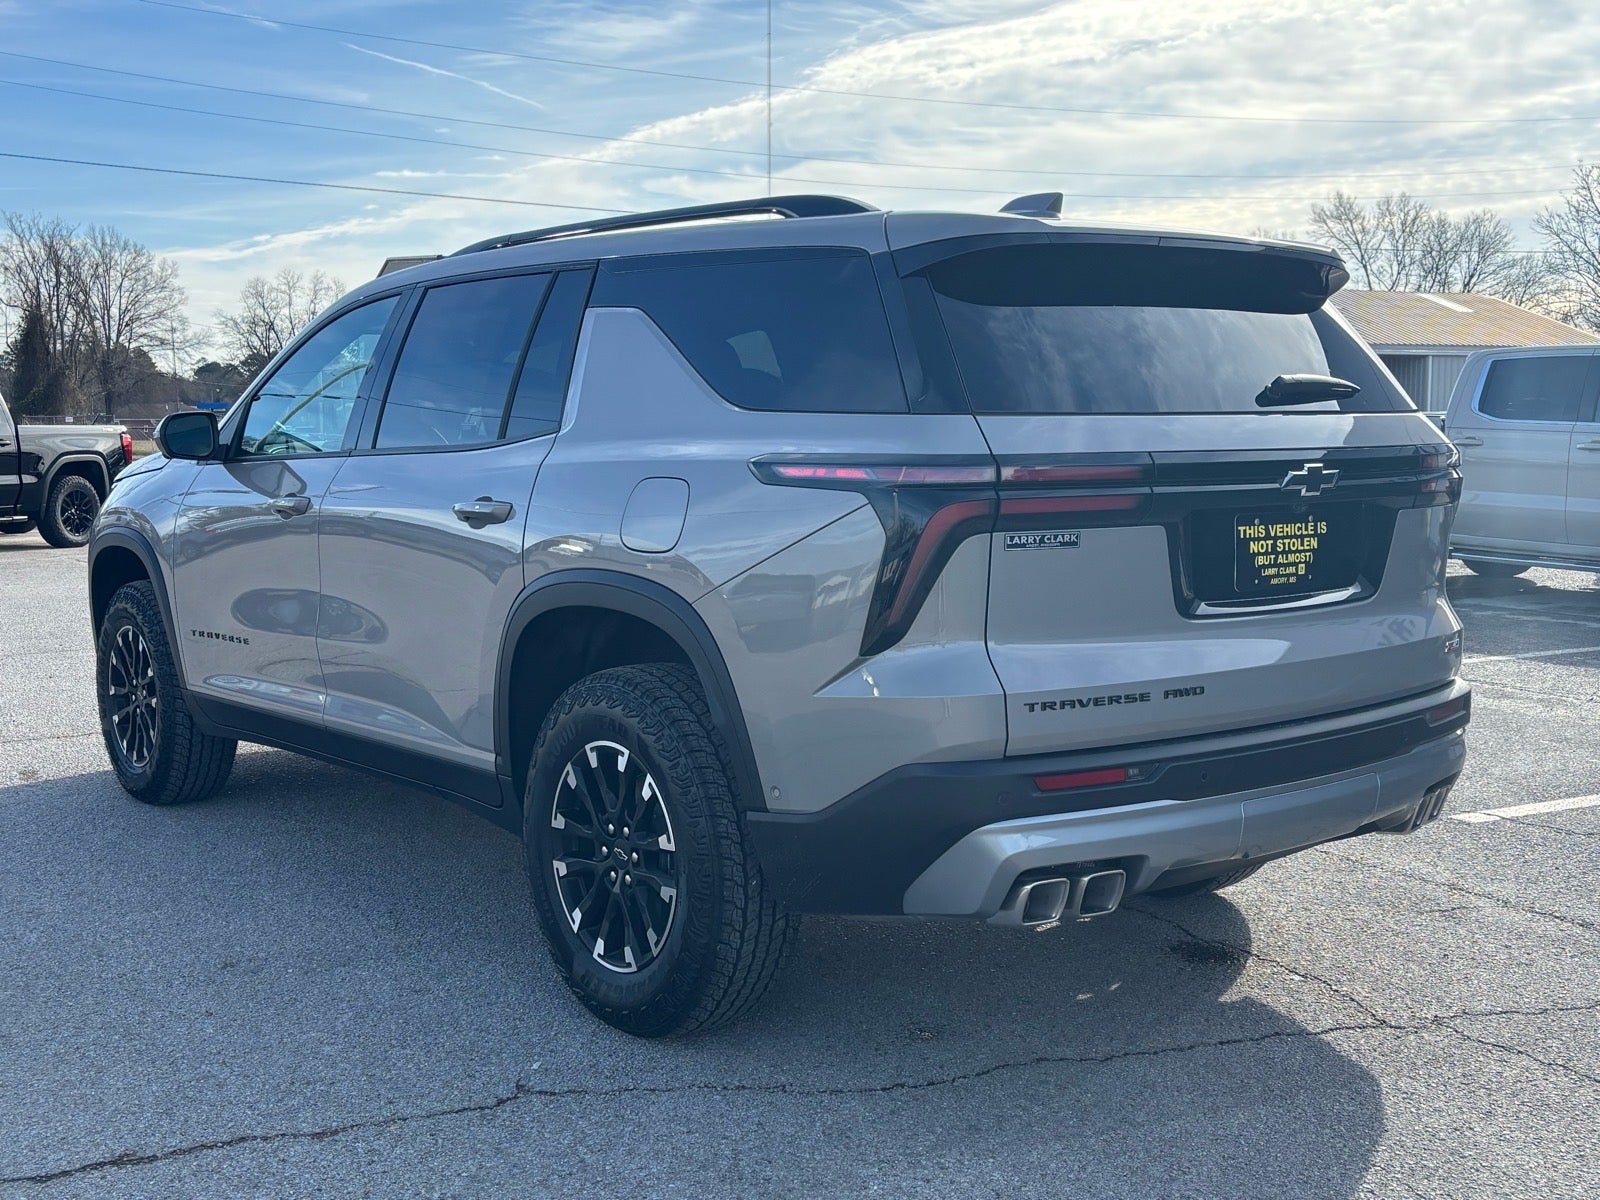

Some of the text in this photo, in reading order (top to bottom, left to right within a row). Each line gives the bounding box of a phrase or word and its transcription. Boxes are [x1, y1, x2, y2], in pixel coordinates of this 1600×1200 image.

[1238, 521, 1327, 538] THIS VEHICLE IS
[1007, 533, 1078, 545] LARRY CLARK
[1250, 537, 1317, 553] NOT STOLEN
[1255, 552, 1313, 568] (BUT ALMOST)
[1261, 567, 1278, 576] LARRY
[1279, 566, 1296, 575] CLARK
[190, 629, 250, 645] TRAVERSE
[1024, 686, 1205, 712] TRAVERSE AWD
